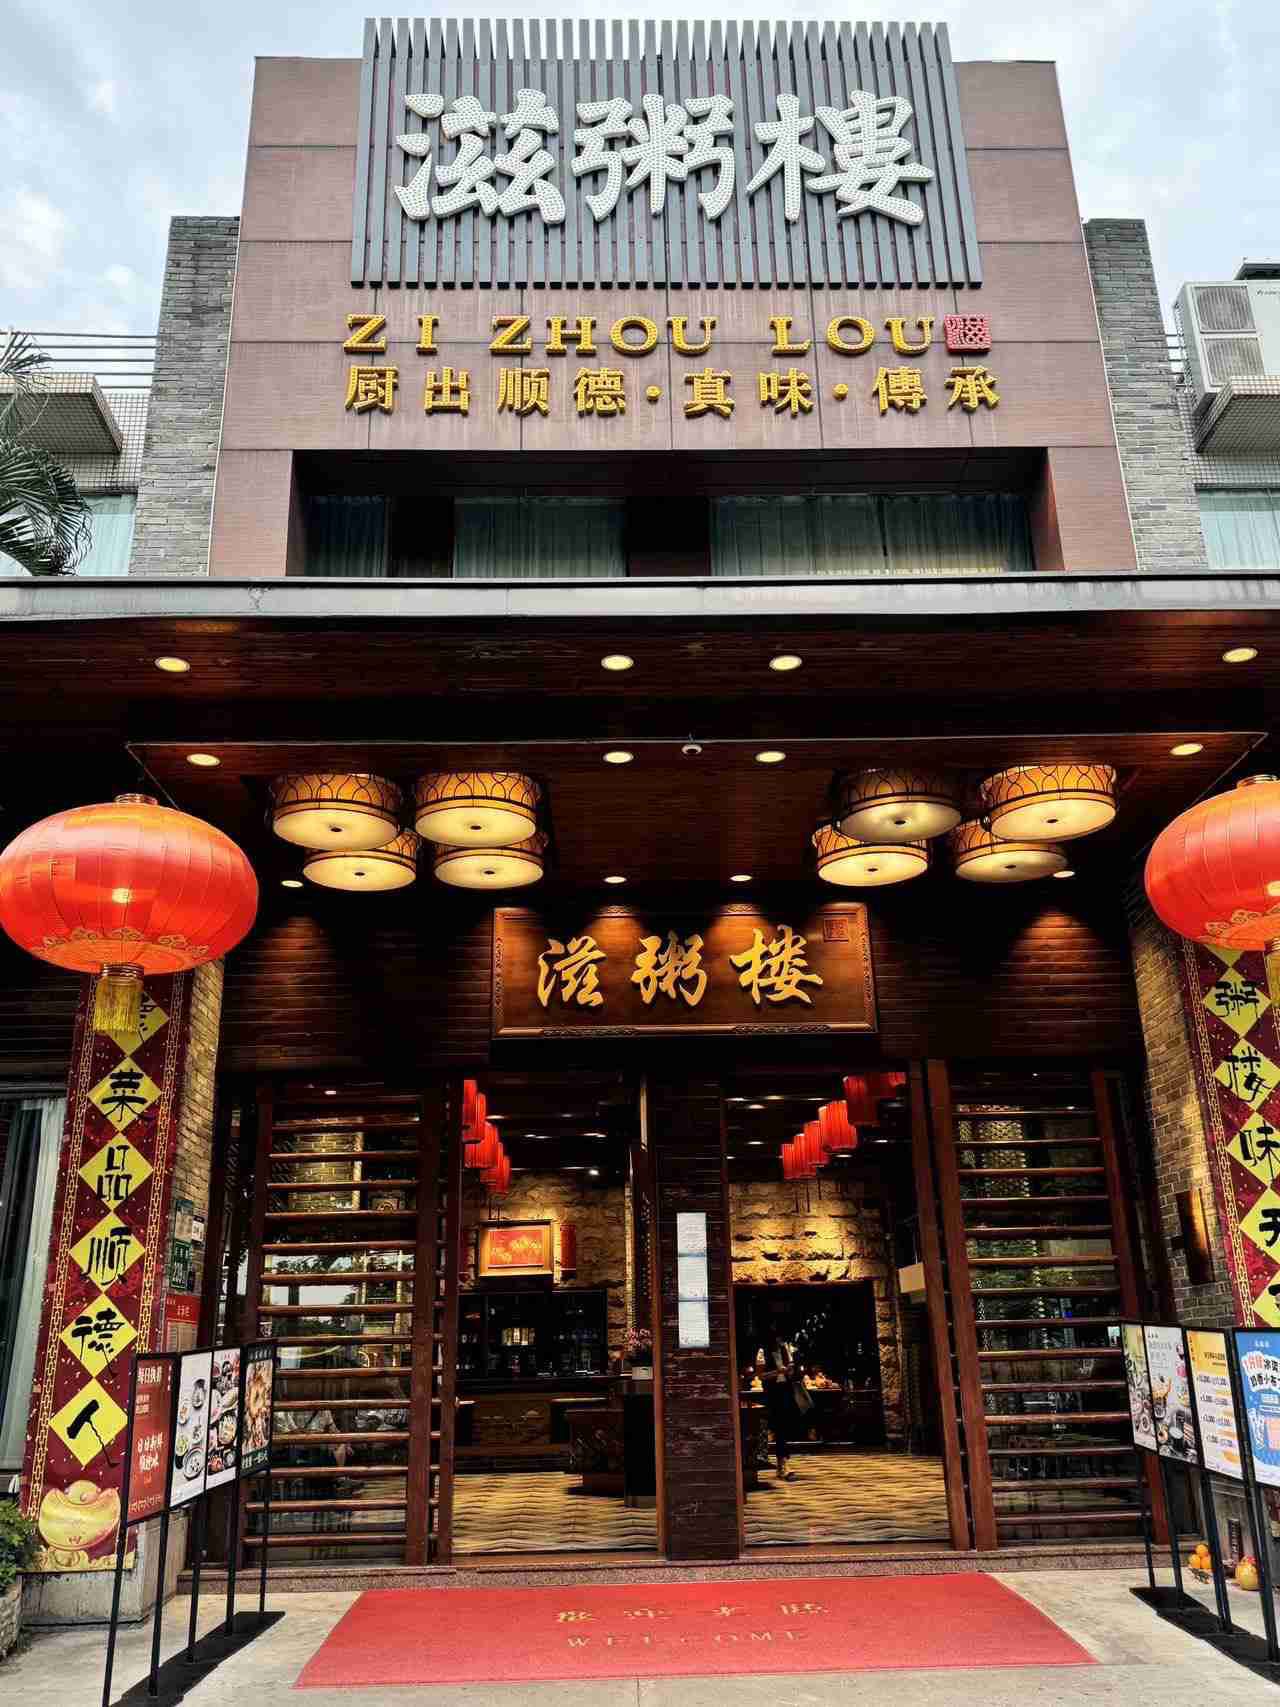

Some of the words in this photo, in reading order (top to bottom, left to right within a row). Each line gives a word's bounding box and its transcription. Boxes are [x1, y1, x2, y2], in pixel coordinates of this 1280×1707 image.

[394, 88, 935, 227] 滋粥樓
[343, 315, 440, 354] ZI
[489, 315, 716, 355] ZHOU
[769, 315, 934, 357] LOU
[538, 924, 824, 1007] 滋粥楼
